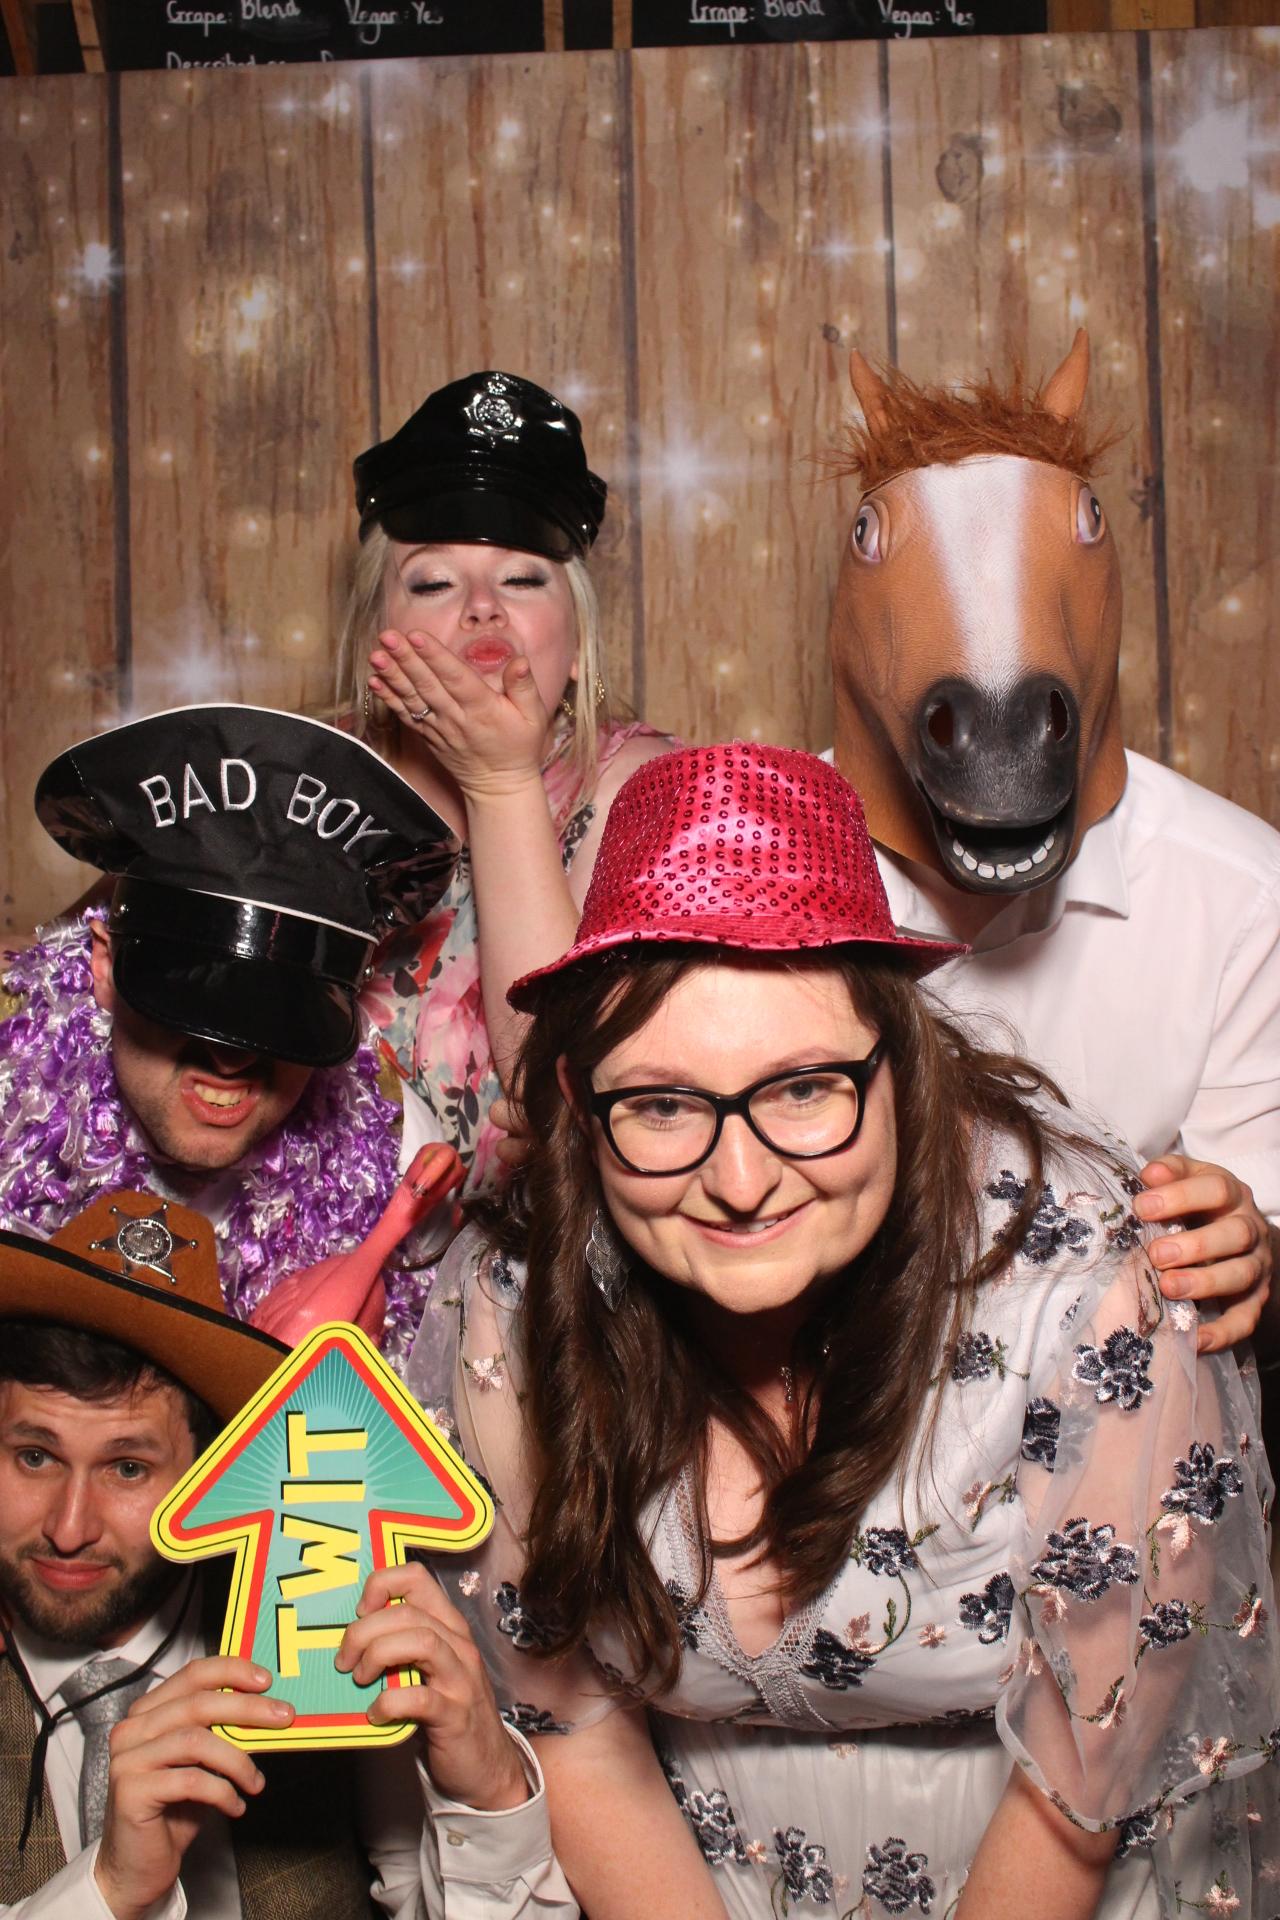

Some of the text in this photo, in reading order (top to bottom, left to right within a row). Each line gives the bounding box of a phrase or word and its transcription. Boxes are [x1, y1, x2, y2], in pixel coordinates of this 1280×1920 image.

[240, 0, 301, 20] Blend
[138, 758, 393, 853] BAD BOY
[275, 1410, 369, 1679] TWIT
